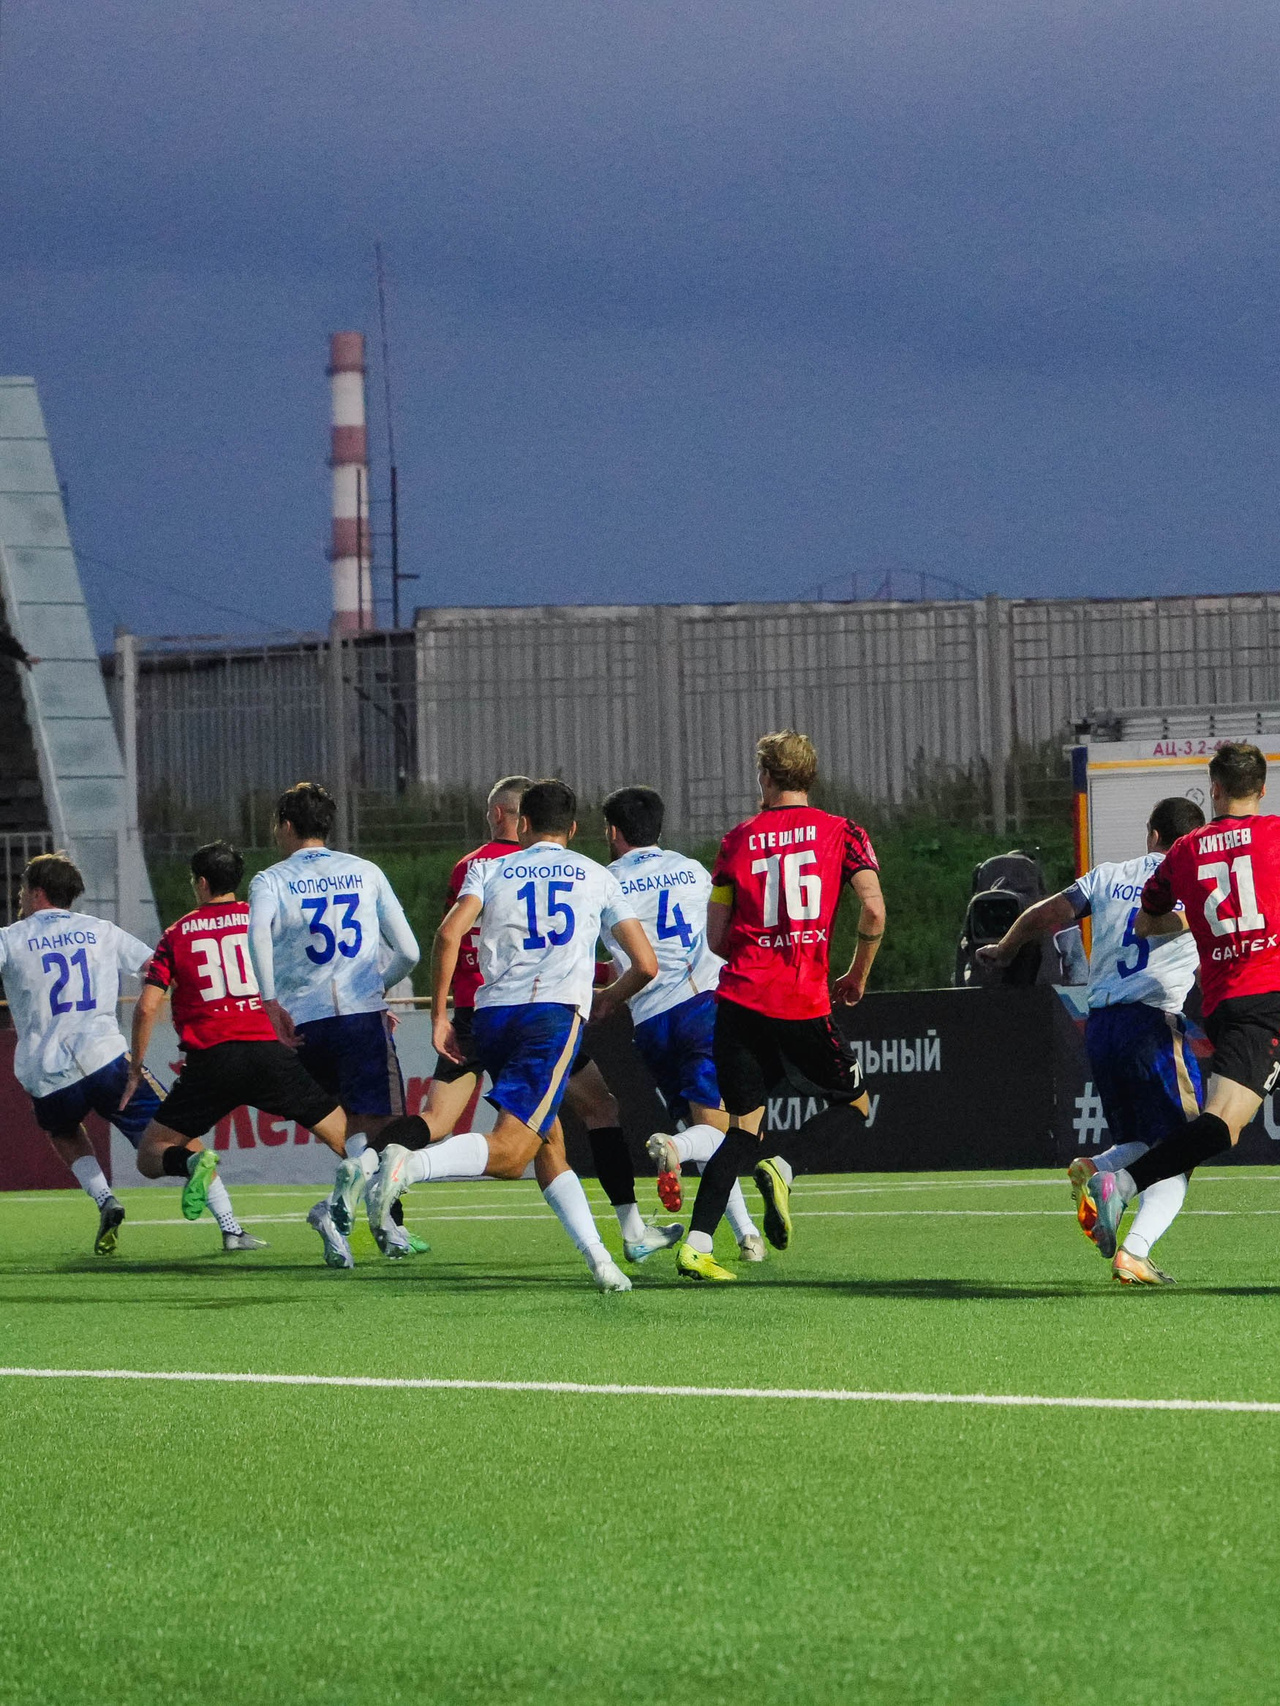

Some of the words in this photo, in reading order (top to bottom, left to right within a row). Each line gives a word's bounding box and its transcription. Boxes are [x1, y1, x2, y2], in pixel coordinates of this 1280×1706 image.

[748, 825, 817, 851] СТЕШИН
[1198, 827, 1252, 855] ХИТЯЕВ
[288, 874, 364, 895] КОЛЮЧКИН
[503, 864, 586, 881] СОКОЛОВ
[620, 870, 697, 895] БАБАХАНОВ
[751, 849, 822, 928] 76
[1197, 854, 1265, 938] 21
[182, 913, 249, 935] РАМАЗАНО
[301, 892, 363, 965] 33
[516, 880, 576, 950] 15
[656, 889, 693, 948] 4
[28, 931, 97, 951] ПАНКОВ
[758, 928, 828, 948] GALTEX
[1116, 906, 1150, 979] 5
[1212, 934, 1278, 961] GALTEX
[41, 947, 97, 1017] 21
[191, 932, 260, 1002] 30
[850, 1029, 941, 1075] ЛЬНЫЙ
